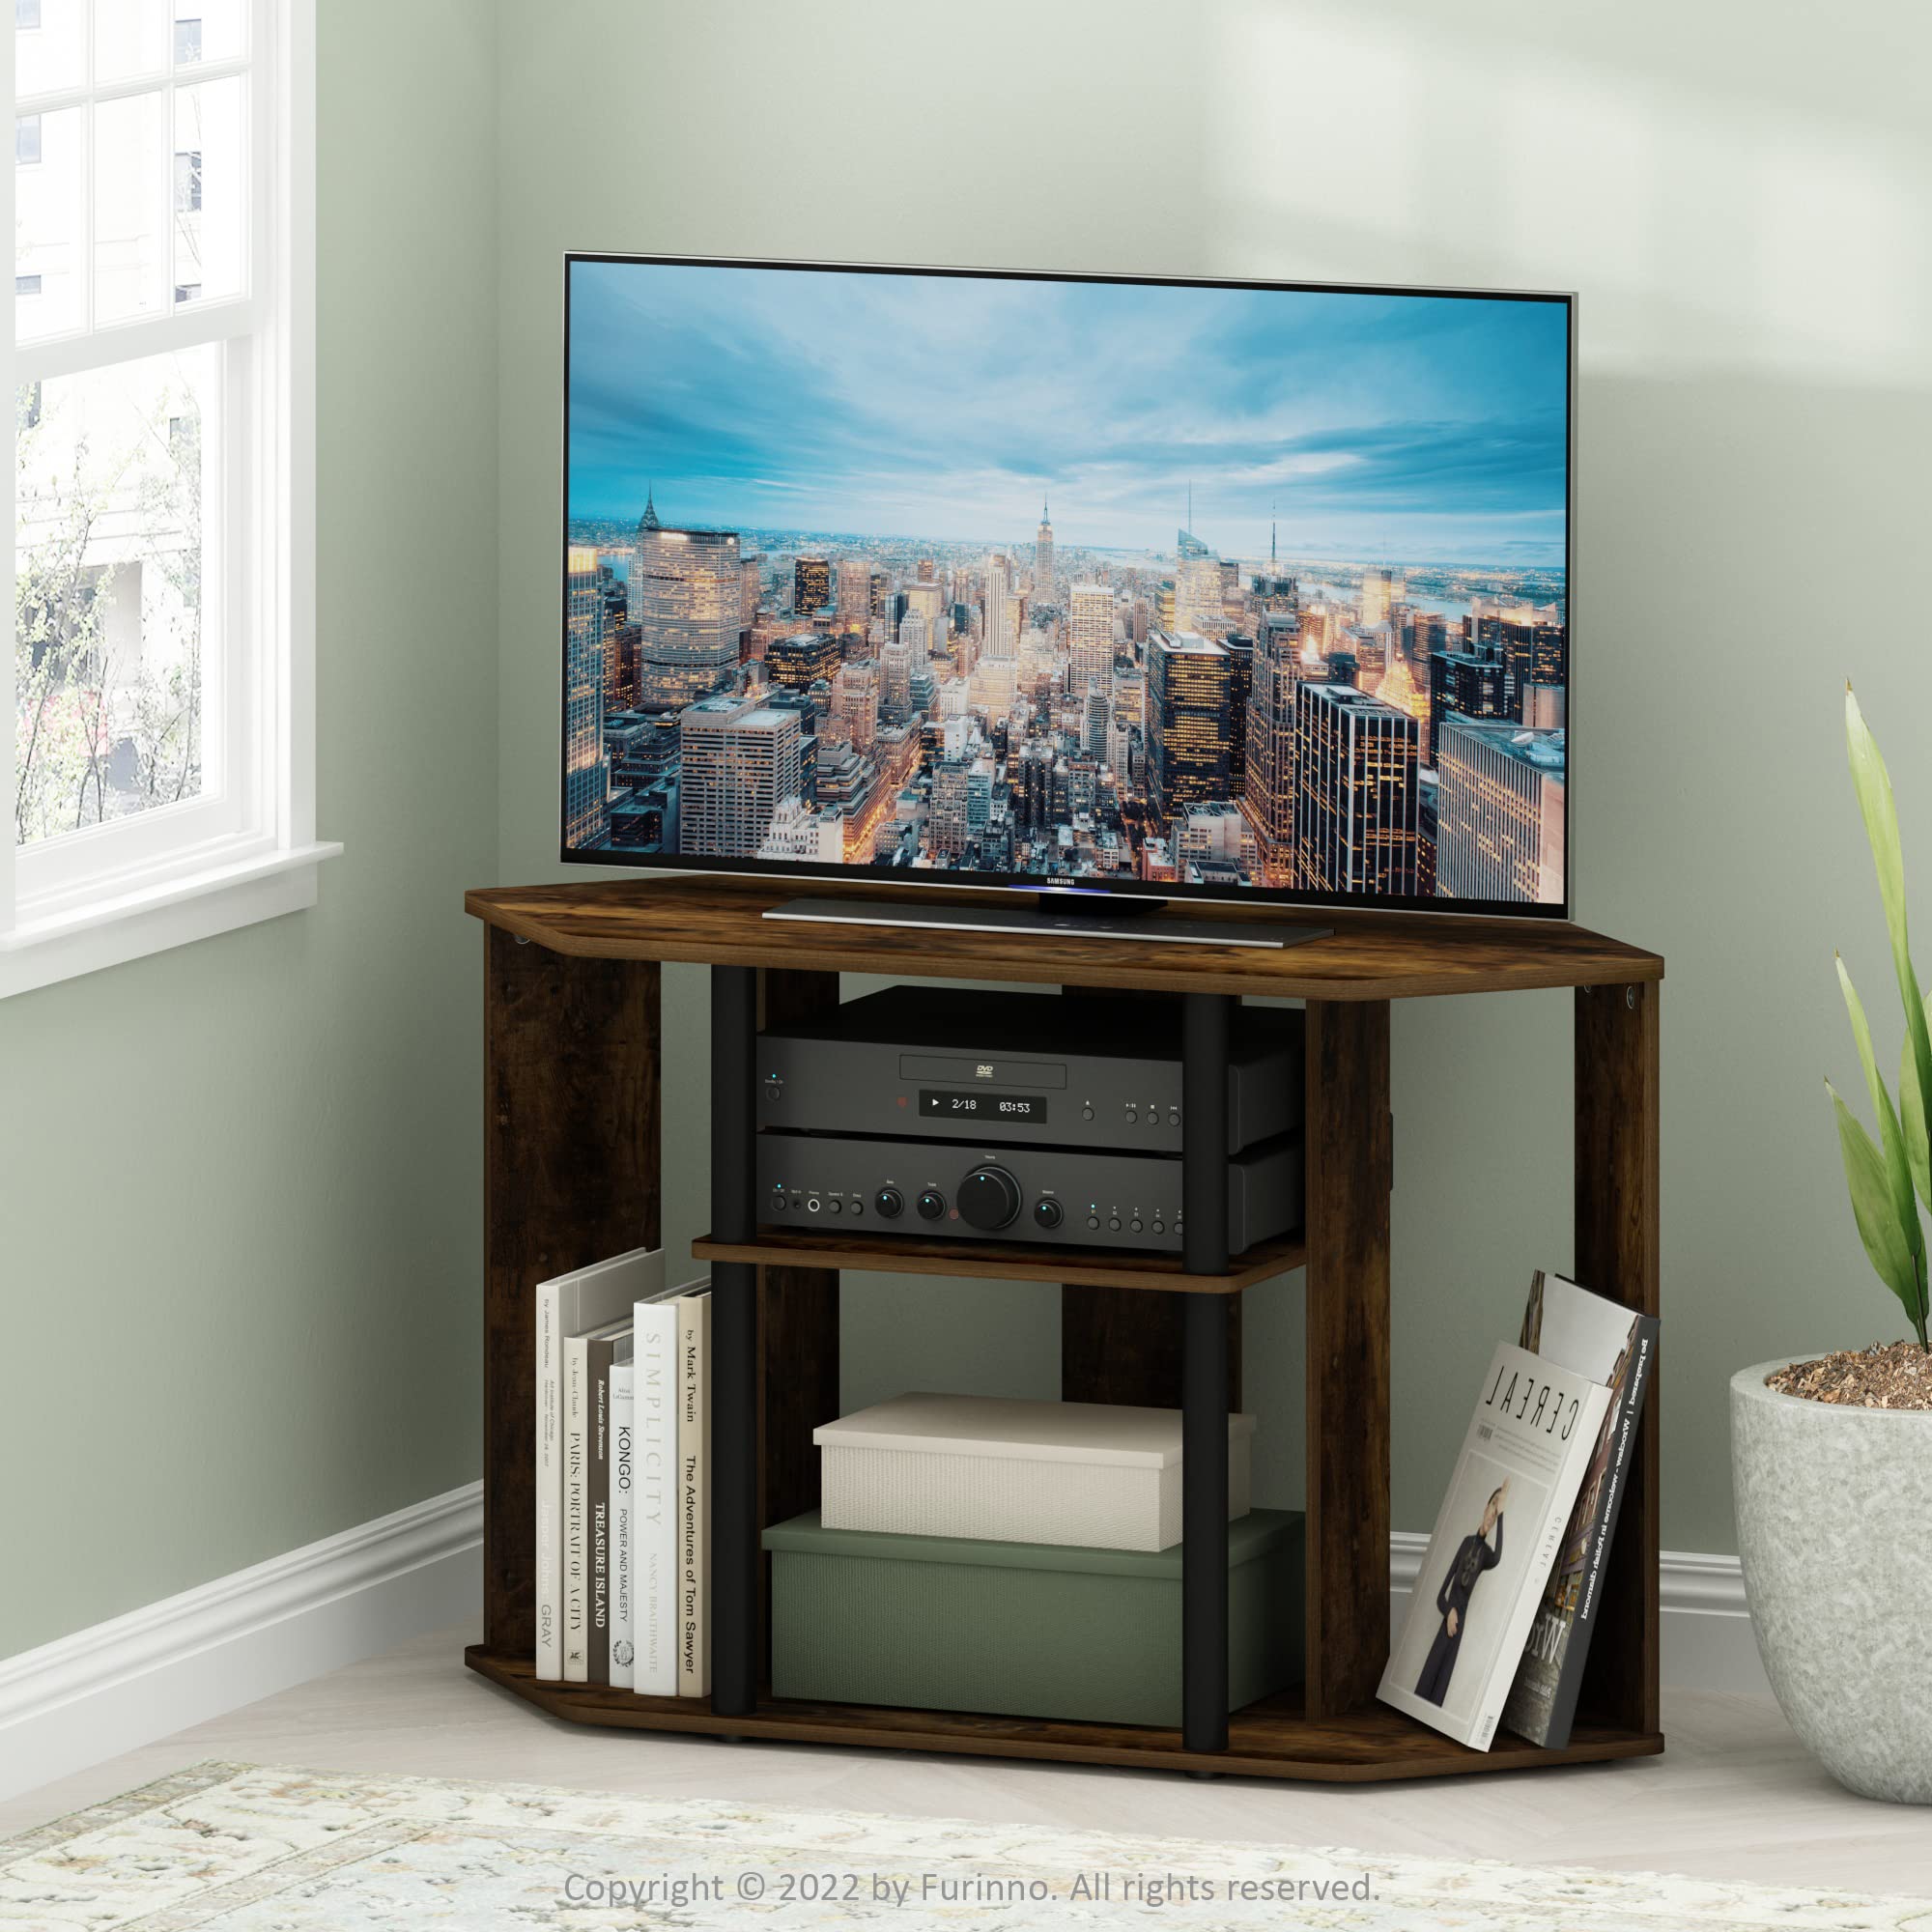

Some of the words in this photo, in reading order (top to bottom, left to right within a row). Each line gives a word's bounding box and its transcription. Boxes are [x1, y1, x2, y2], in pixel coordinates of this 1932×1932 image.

[1046, 877, 1075, 886] SAMSUNG
[952, 1098, 977, 1110] 2/18
[999, 1101, 1031, 1113] 03:53
[543, 1298, 551, 1307] by
[686, 1329, 695, 1342] by
[571, 1357, 580, 1366] by
[687, 1346, 696, 1378] Mark
[571, 1369, 580, 1418] Jean-Claude
[687, 1383, 696, 1423] Twain
[645, 1332, 662, 1526] SIMPLICITY
[570, 1433, 582, 1478] PARIS:
[618, 1426, 631, 1494] KONGO:
[686, 1455, 696, 1482] The
[540, 1500, 552, 1548] Jasper
[570, 1482, 582, 1558] PORTRAIT
[595, 1502, 606, 1574] TREASURE
[619, 1508, 628, 1548] POWER
[686, 1485, 696, 1566] Adventures
[570, 1560, 582, 1581] OF
[619, 1549, 628, 1572] AND
[648, 1552, 658, 1593] NANCY
[686, 1570, 696, 1583] of
[570, 1583, 582, 1594] A
[595, 1577, 606, 1629] ISLAND
[619, 1574, 628, 1623] MAJESTY
[686, 1587, 696, 1616] Tom
[541, 1604, 552, 1648] GRAY
[570, 1598, 582, 1633] CITY
[648, 1596, 658, 1673] BRAITHWAITE
[684, 1621, 696, 1674] Sawyer
